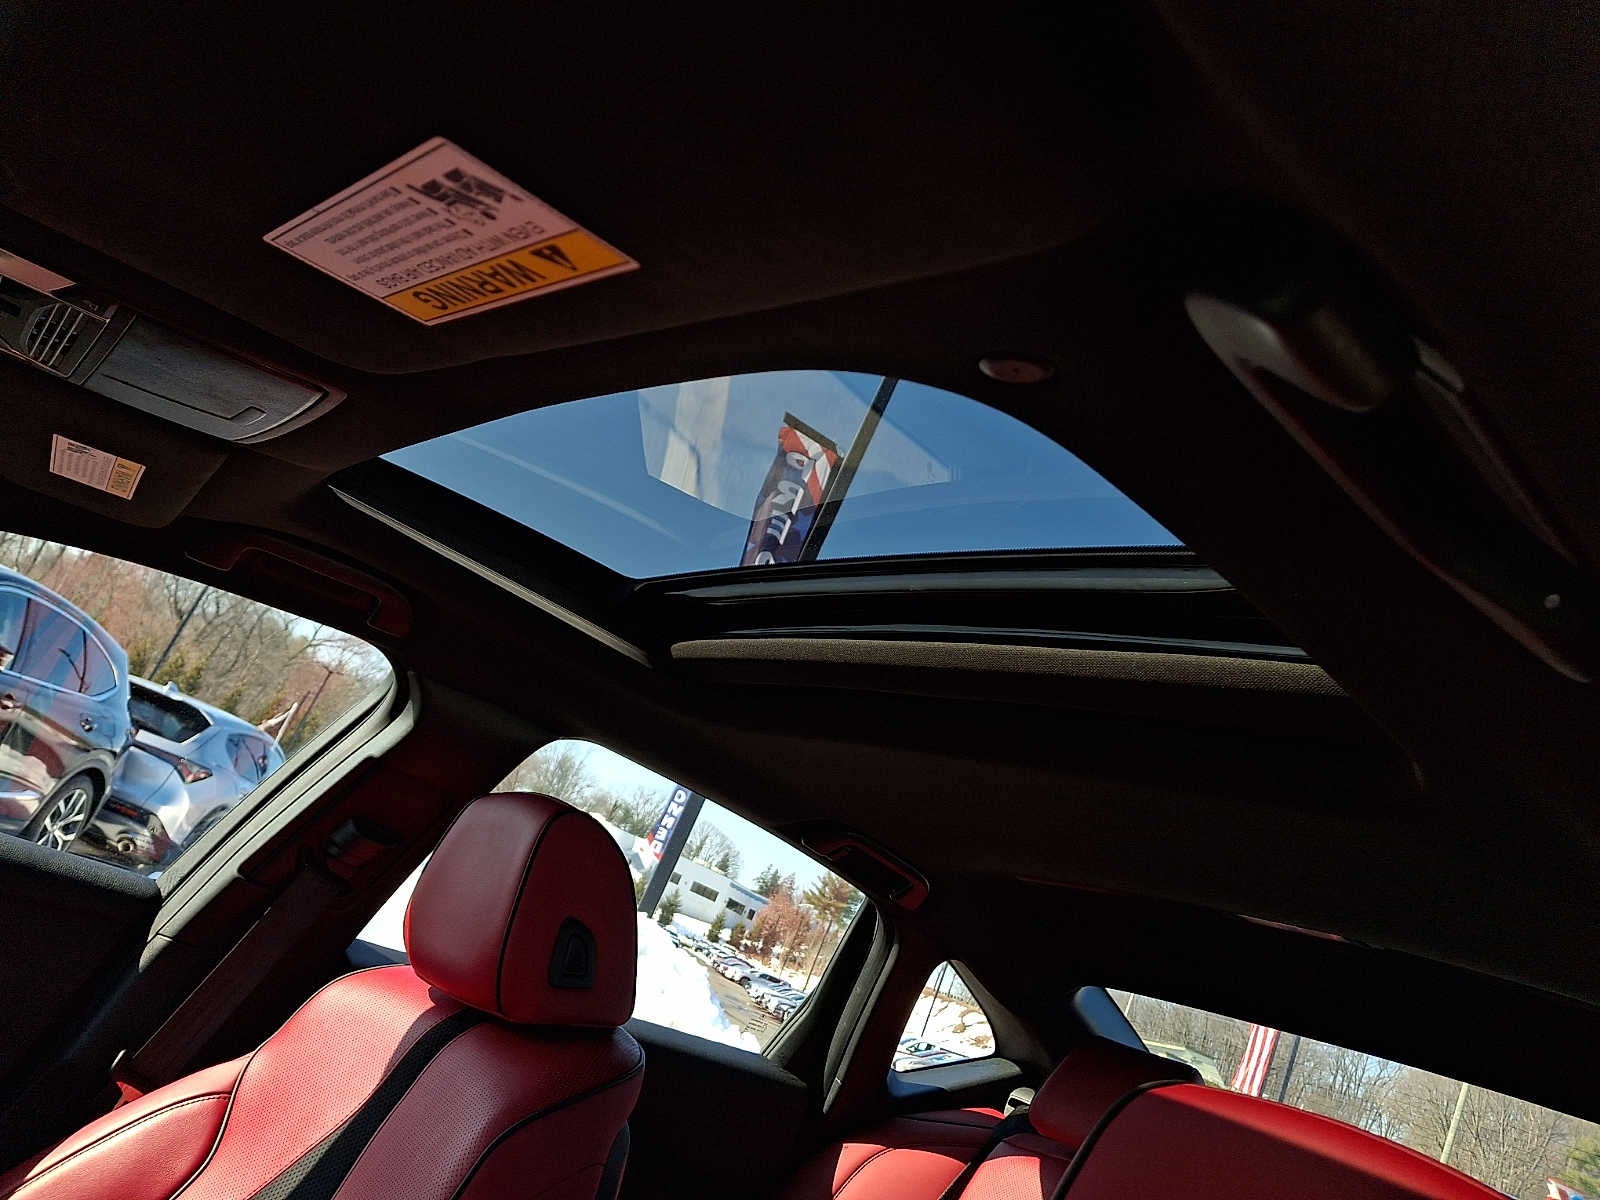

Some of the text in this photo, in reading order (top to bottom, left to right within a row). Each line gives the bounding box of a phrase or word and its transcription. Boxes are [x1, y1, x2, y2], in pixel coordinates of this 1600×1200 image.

[499, 220, 546, 242] EVEN
[414, 245, 482, 274] ADVANCED
[411, 258, 547, 311] WARNING
